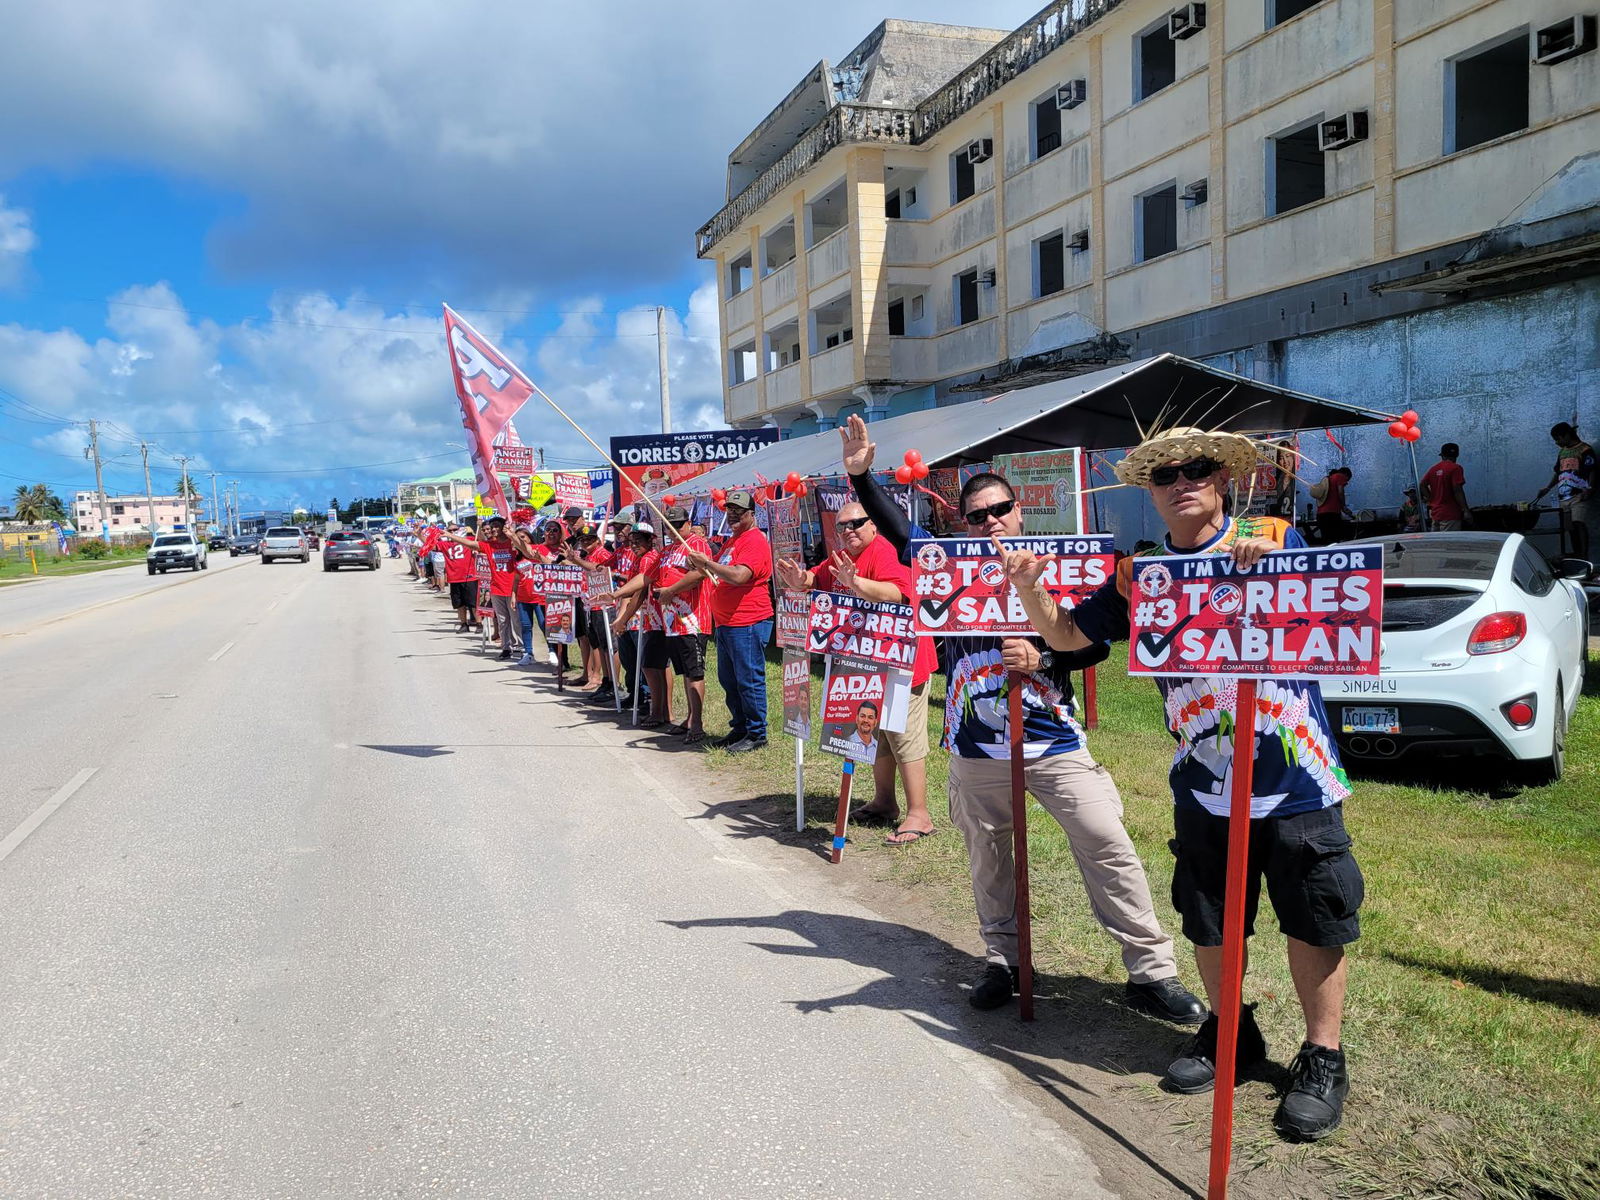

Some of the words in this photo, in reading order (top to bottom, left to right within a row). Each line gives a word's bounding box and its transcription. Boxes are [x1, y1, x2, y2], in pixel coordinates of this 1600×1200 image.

[619, 447, 681, 464] TORRES
[1011, 454, 1046, 469] PLEASE
[1048, 453, 1073, 468] VOTE
[589, 471, 612, 480] VOTE
[956, 543, 982, 556] I'M
[989, 541, 1058, 556] VOTING
[1064, 540, 1102, 554] FOR
[1183, 561, 1214, 577] I'M
[1316, 552, 1365, 571] FOR
[915, 572, 953, 596] #3
[956, 559, 1106, 587] TORES
[544, 582, 582, 592] SABLAN
[547, 600, 572, 612] ADA
[838, 596, 853, 607] I'M
[856, 600, 899, 615] VOTING
[956, 596, 1092, 624] SABA
[1134, 598, 1177, 627] #3
[811, 613, 834, 630] #3
[831, 632, 916, 665] SABLAN
[1179, 626, 1373, 663] SABLAN
[784, 660, 809, 681] ADA
[841, 660, 857, 668] PLEASE
[857, 663, 878, 672] RE-ELECT
[829, 675, 883, 694] ADA
[829, 692, 849, 701] ROY
[850, 691, 883, 700] ALDAN
[1344, 713, 1367, 728] ACU
[1374, 713, 1396, 728] 773
[829, 737, 859, 752] PRECINCT
